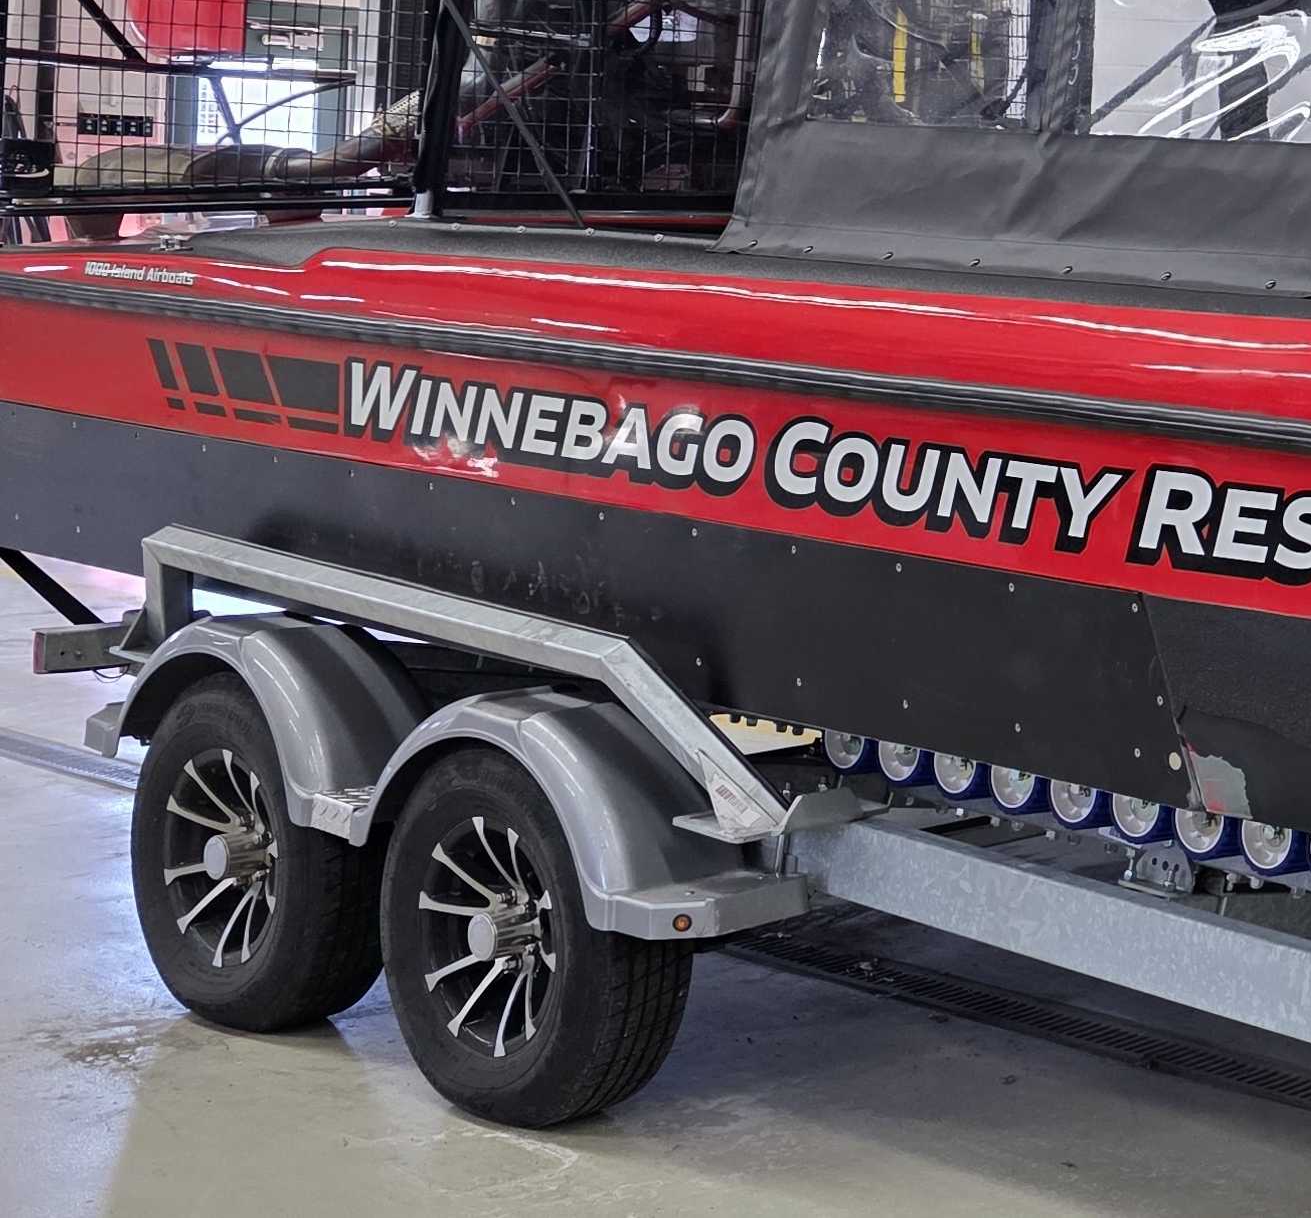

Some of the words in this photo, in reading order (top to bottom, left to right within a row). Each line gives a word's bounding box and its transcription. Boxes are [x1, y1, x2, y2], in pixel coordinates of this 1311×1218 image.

[146, 267, 194, 286] Airboats
[347, 358, 757, 486] WINNEBAGO
[773, 418, 1124, 540] COUNTY
